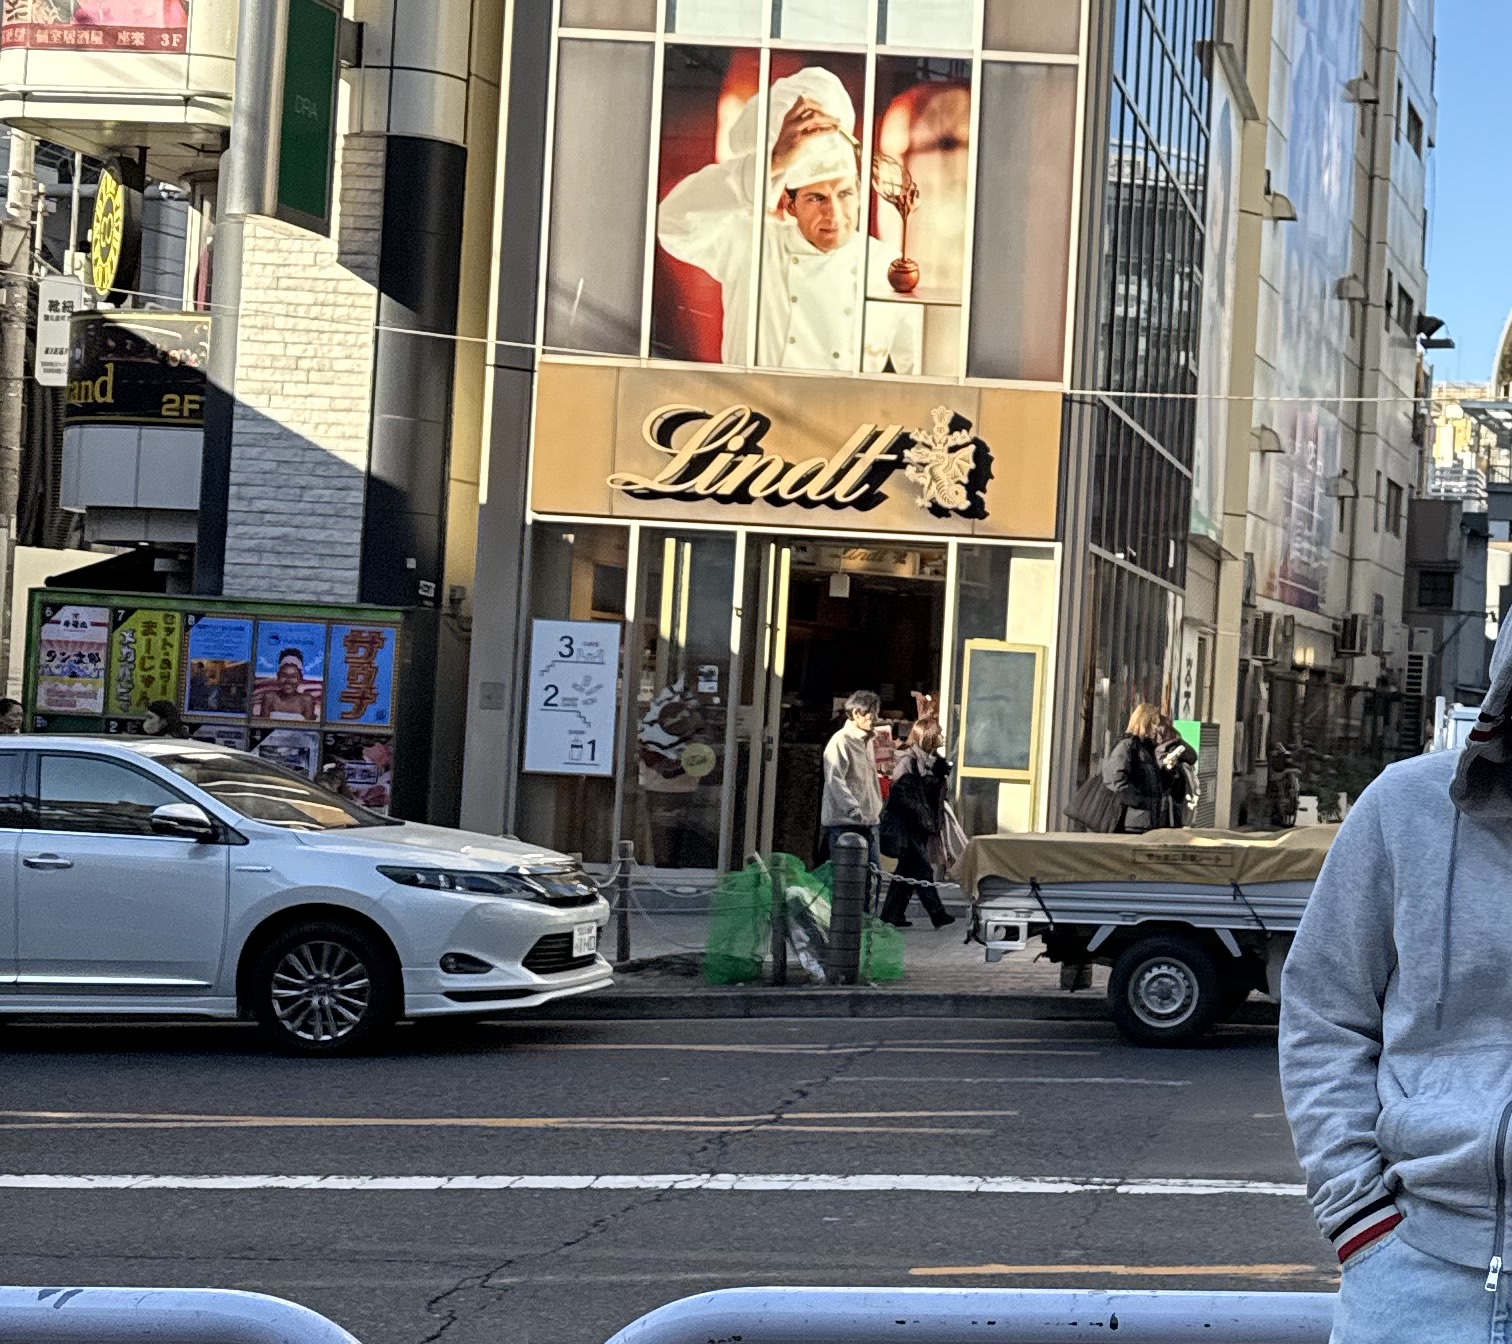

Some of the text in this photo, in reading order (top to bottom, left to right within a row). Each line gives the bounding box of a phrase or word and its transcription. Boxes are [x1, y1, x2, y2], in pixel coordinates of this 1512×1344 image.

[160, 33, 183, 48] 3F
[161, 393, 205, 417] 2F
[606, 404, 904, 503] Lindt
[117, 609, 126, 622] 7
[557, 635, 575, 659] 3
[340, 629, 388, 720] サウナ
[543, 684, 559, 707] 2
[586, 738, 597, 762] 1
